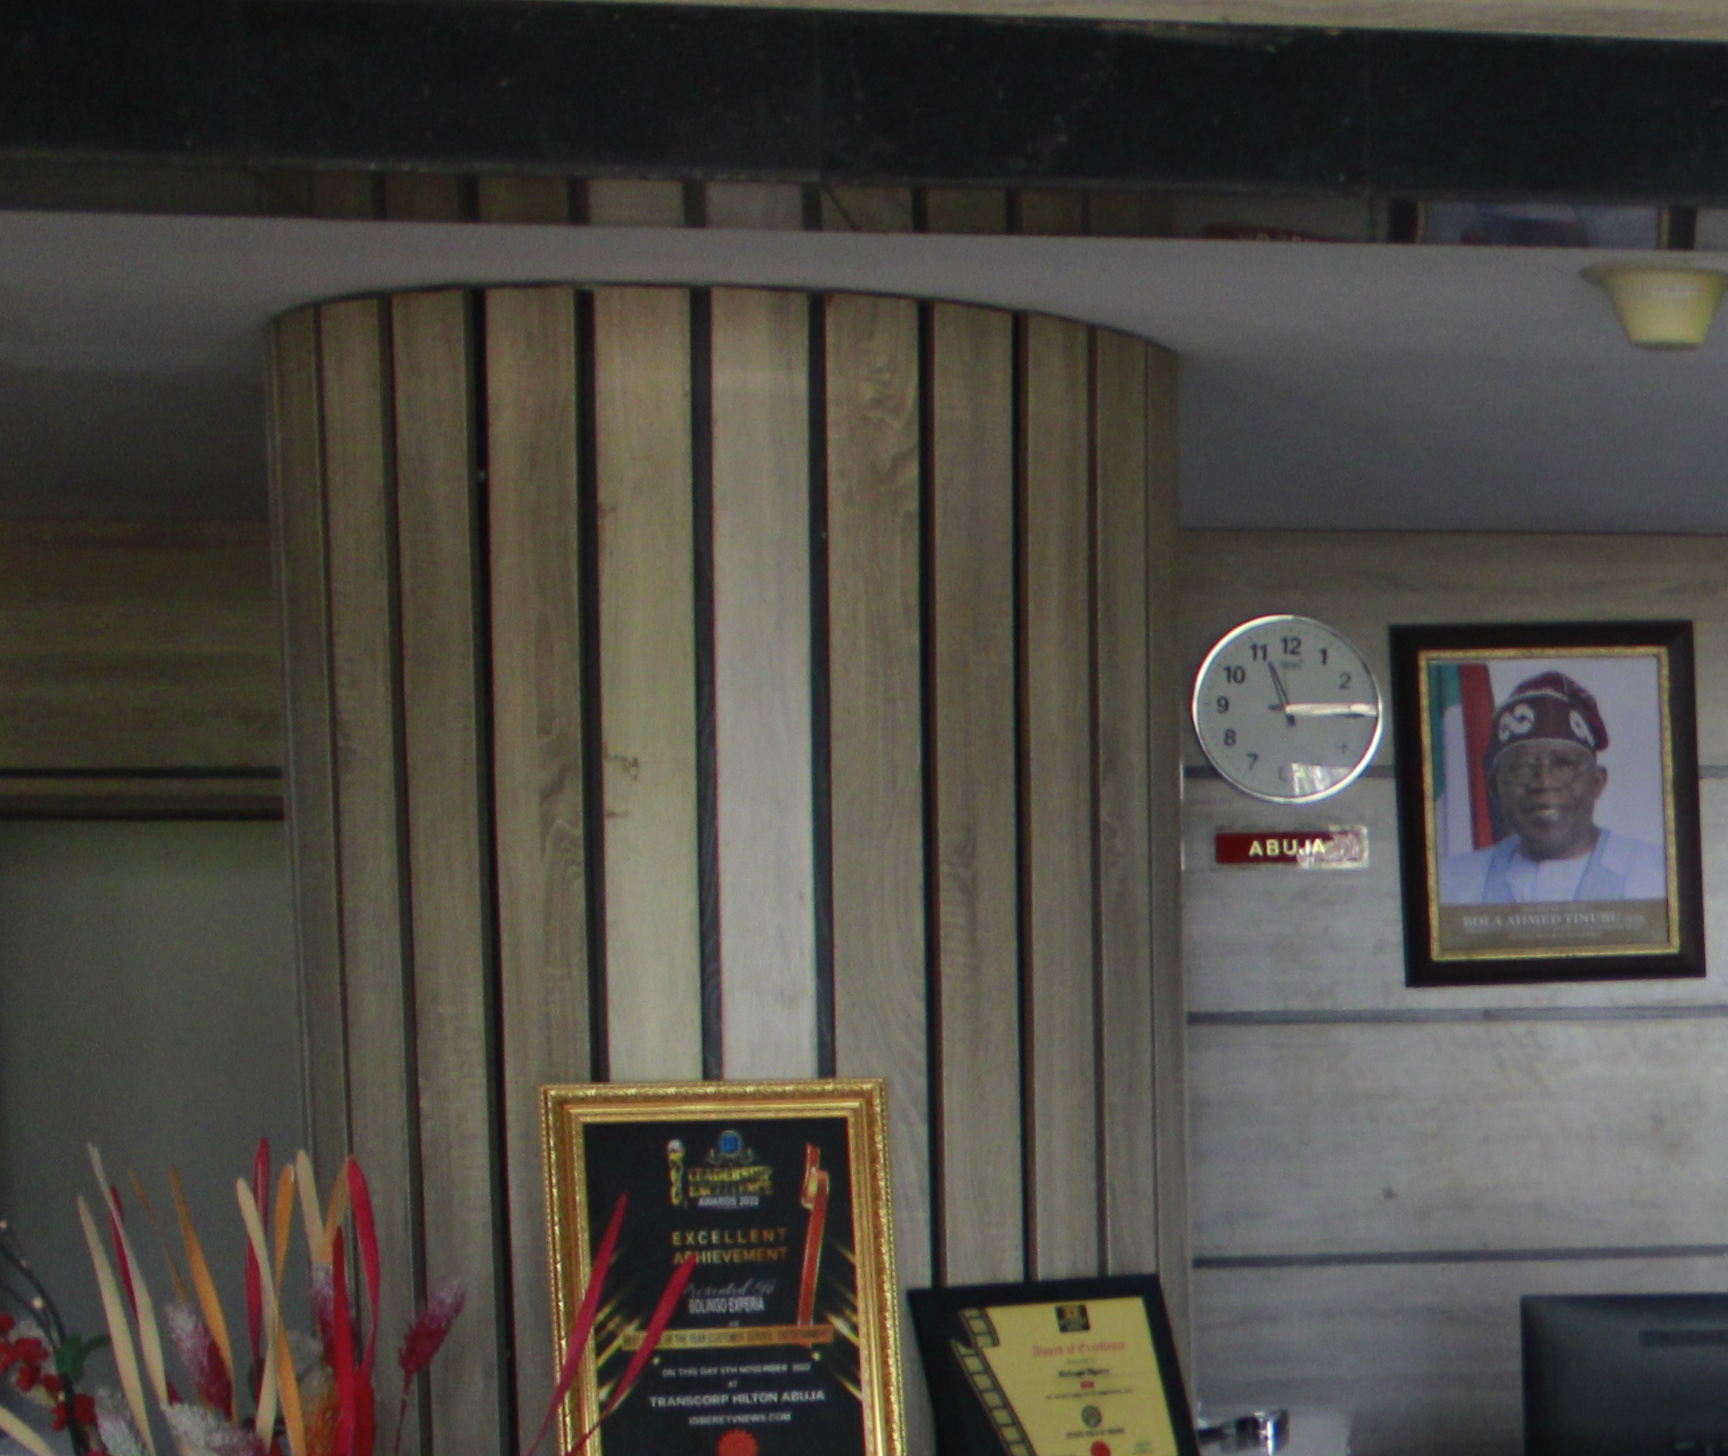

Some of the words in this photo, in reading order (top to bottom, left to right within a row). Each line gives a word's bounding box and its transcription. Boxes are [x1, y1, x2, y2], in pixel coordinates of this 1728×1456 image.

[1250, 643, 1268, 661] 11
[1281, 637, 1301, 656] 12
[1319, 647, 1328, 665] 1
[1224, 665, 1246, 684] 10
[1339, 672, 1351, 689] 2
[1217, 696, 1229, 713] 9
[1224, 728, 1236, 746] 8
[1247, 753, 1259, 771] 7
[1249, 837, 1326, 857] ABUJA
[672, 1228, 786, 1246] EXCELLENT
[699, 1366, 719, 1376] DAY
[648, 1394, 729, 1408] TRANSCORP
[731, 1391, 779, 1406] HILTON
[780, 1388, 826, 1403] ABUJA
